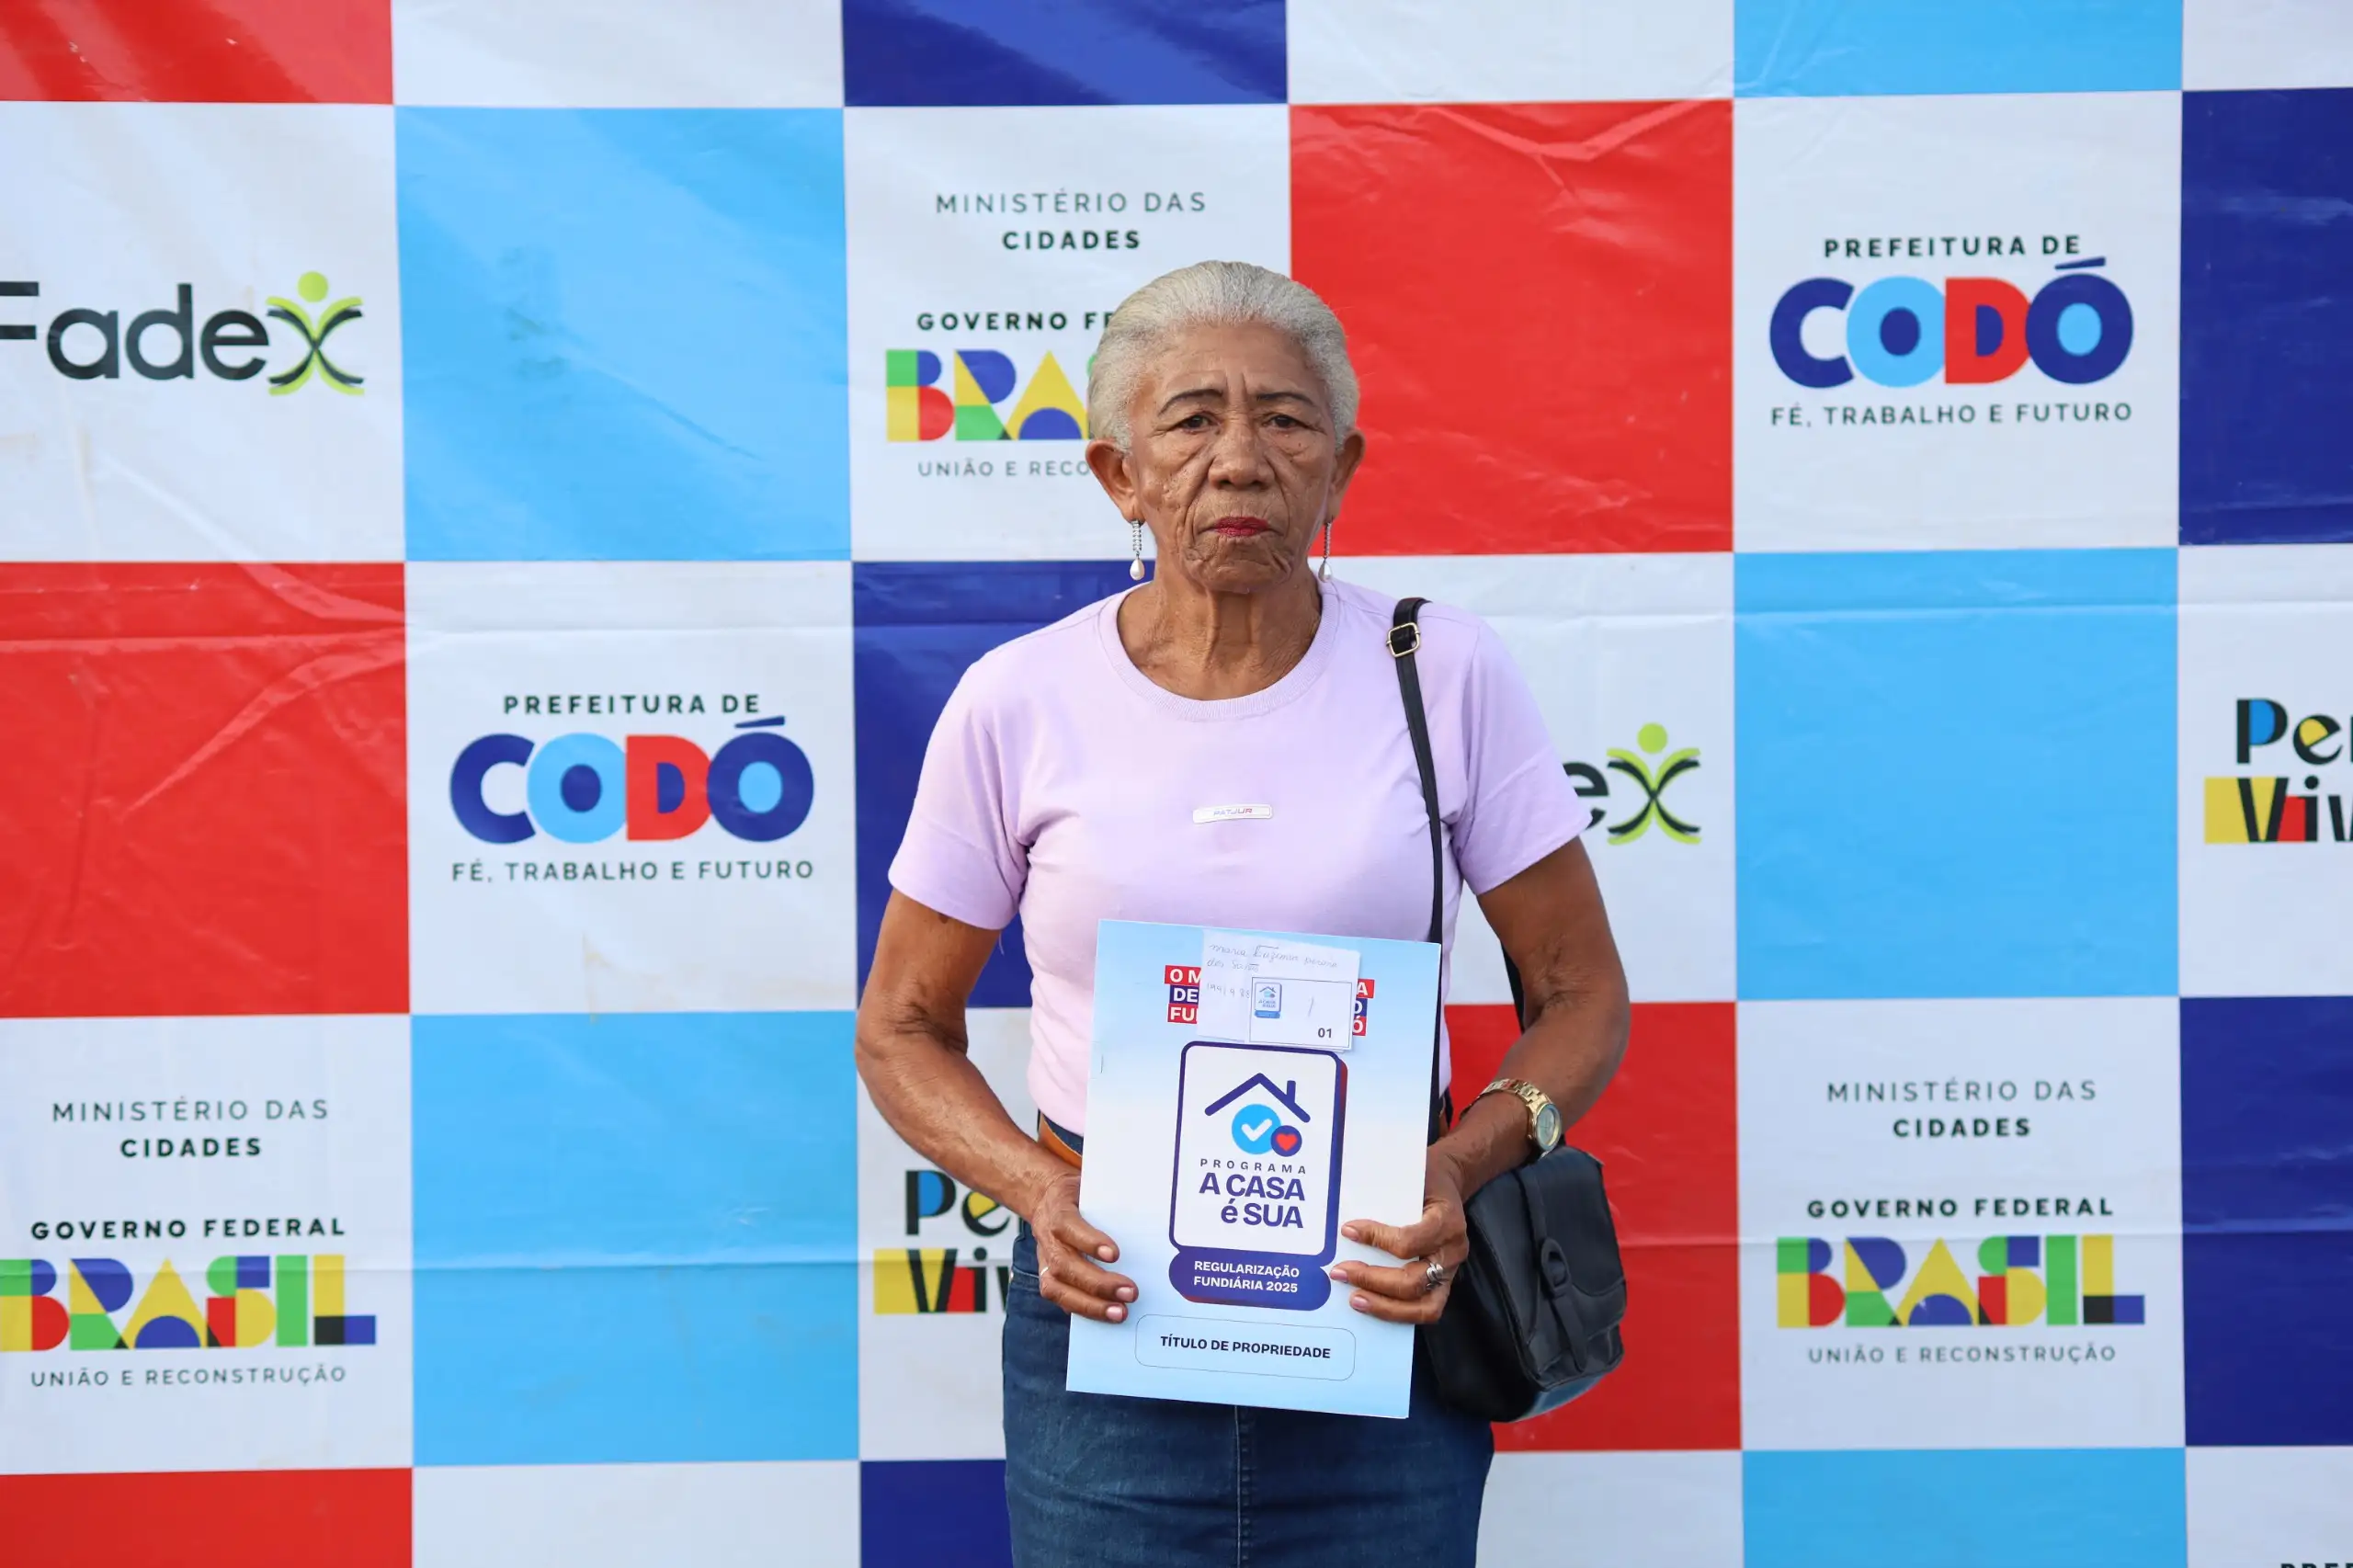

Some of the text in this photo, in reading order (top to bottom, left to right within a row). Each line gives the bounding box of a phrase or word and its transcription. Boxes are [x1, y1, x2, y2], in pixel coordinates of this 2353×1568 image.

[936, 187, 1206, 213] MINISTÉRIO DAS
[1002, 230, 1140, 250] CIDADES
[1824, 235, 2080, 257] PREFEITURA DE
[917, 312, 1067, 331] GOVERNO
[1769, 256, 2133, 389] CODÓ
[886, 348, 1097, 442] BRA
[1771, 403, 2132, 427] FÉ, TRABALHO E FUTURO
[917, 458, 994, 477] UNIÃO
[1006, 461, 1017, 476] E
[504, 695, 760, 714] PREFEITURA DE
[2236, 699, 2353, 766] Pe
[450, 715, 814, 844] CODÓ
[2237, 775, 2353, 843] Viv
[451, 858, 813, 882] FÉ, TRABALHO E FUTURO
[1170, 969, 1183, 983] O
[1318, 1028, 1332, 1038] 01
[1827, 1077, 2097, 1102] MINISTÉRIO DAS
[52, 1096, 328, 1122] MINISTÉRIO DAS
[1893, 1118, 2031, 1138] CIDADES
[120, 1138, 262, 1158] CIDADES
[1199, 1158, 1306, 1175] PROGRAMA
[1199, 1172, 1305, 1201] A CASA
[1221, 1198, 1303, 1229] é SUA
[1807, 1198, 2114, 1218] GOVERNO FEDERAL
[30, 1219, 346, 1240] GOVERNO FEDERAL
[1194, 1260, 1300, 1278] REGULARIZAÇÃO
[1194, 1276, 1298, 1293] FUNDIÁRIA 2025
[1777, 1234, 2145, 1328] BRASIL
[0, 1254, 377, 1352] BRASIL
[1160, 1334, 1331, 1359] TÍTULO DE PROPRIEDADE
[1809, 1342, 2116, 1365] UNIÃO E RECONSTRUÇÃO
[30, 1365, 347, 1387] UNIÃO E RECONSTRUÇÃO
